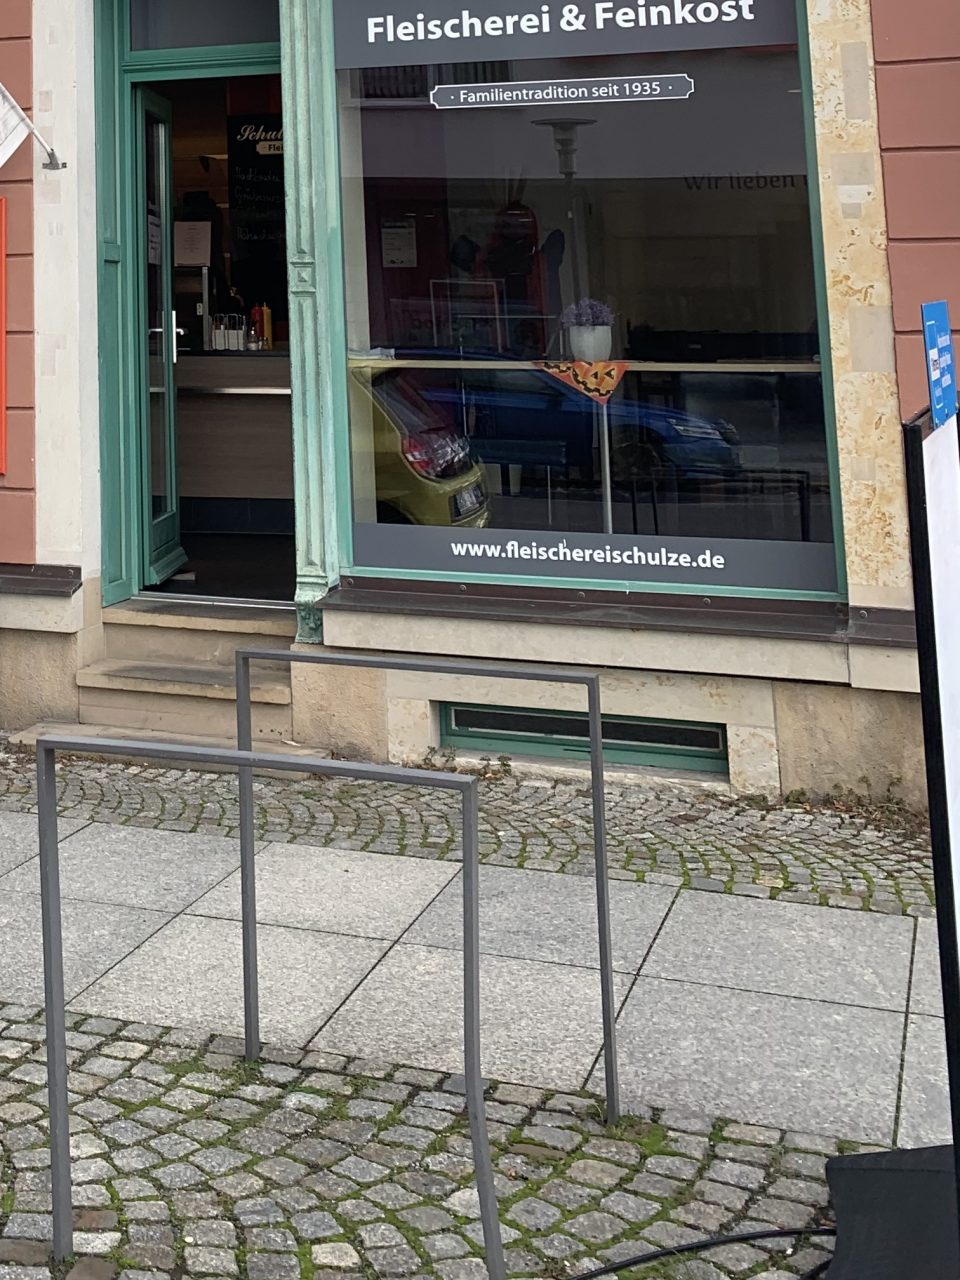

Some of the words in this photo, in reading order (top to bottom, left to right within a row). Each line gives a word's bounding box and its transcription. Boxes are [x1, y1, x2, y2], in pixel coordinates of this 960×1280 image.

[367, 4, 550, 43] Fleischerei
[559, 4, 586, 32] &
[459, 83, 588, 104] Familientradition
[591, 83, 619, 99] seit
[622, 81, 661, 96] 1935
[237, 124, 283, 141] Schul
[684, 173, 722, 191] Wir
[729, 171, 796, 190] lieben
[451, 540, 725, 569] www.fleischereischulze.de
